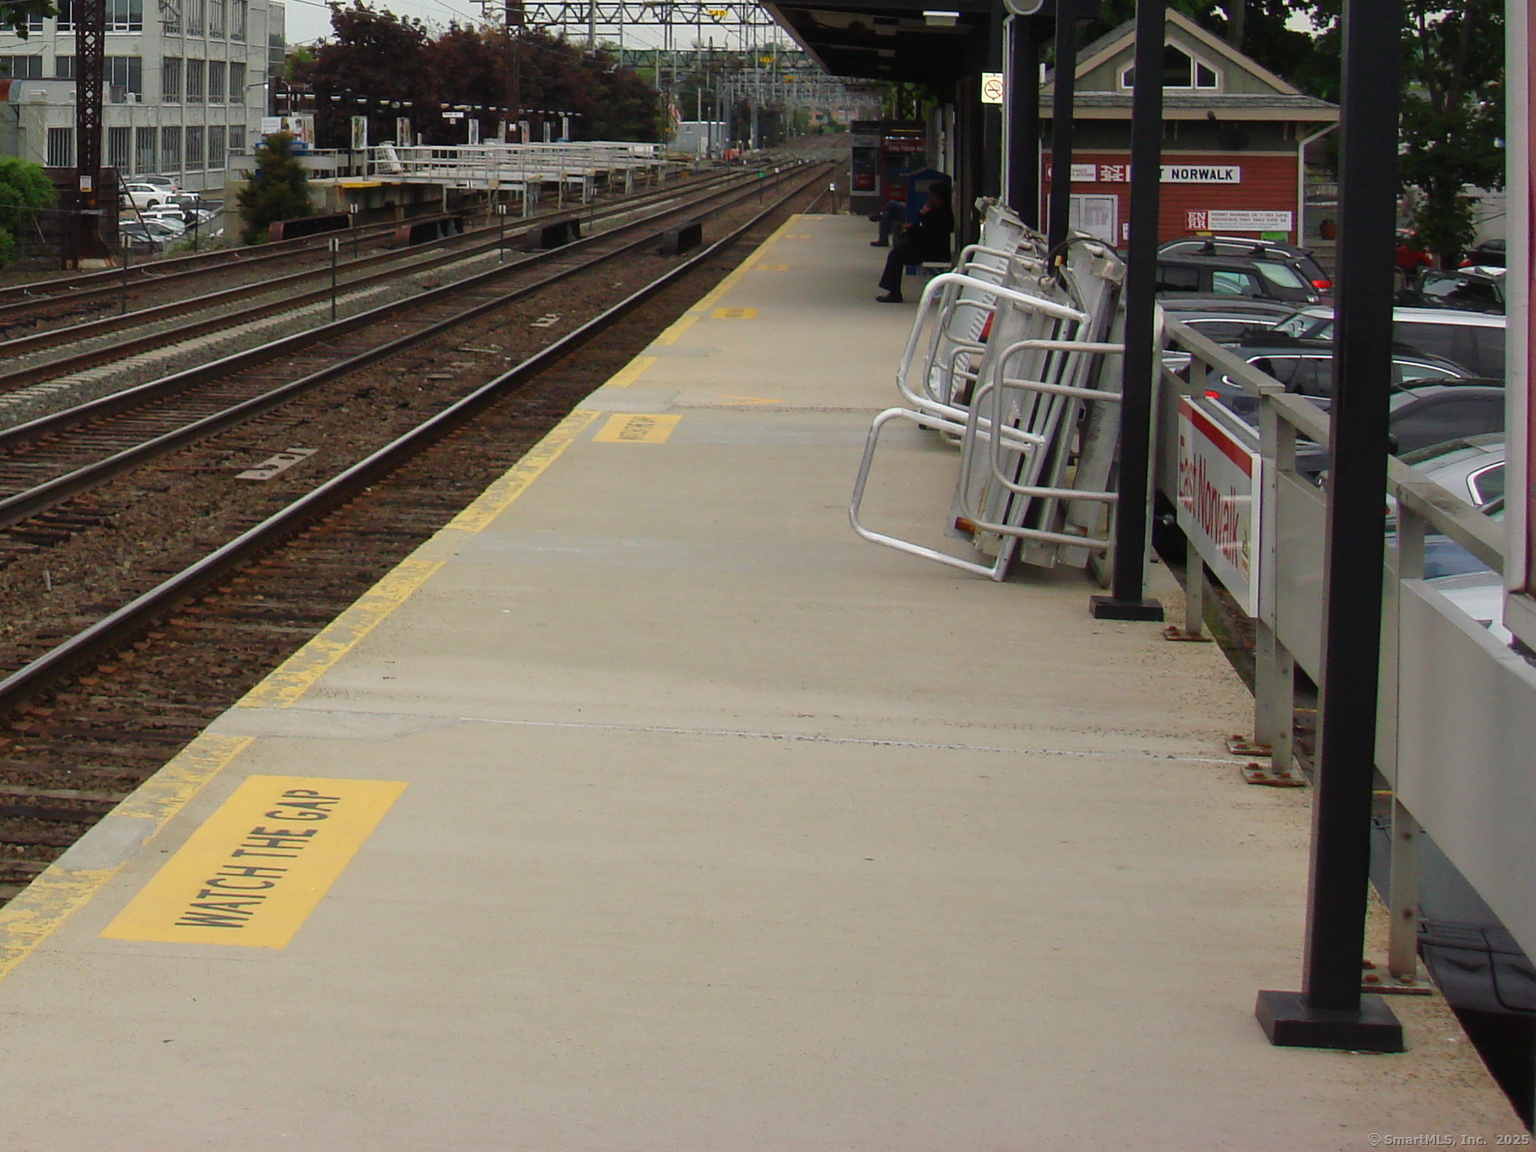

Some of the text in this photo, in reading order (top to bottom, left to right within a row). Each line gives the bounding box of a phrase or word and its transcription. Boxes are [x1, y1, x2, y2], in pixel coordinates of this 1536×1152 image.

[1171, 168, 1234, 180] NORWALK
[1178, 434, 1239, 570] East Norwalk
[174, 788, 342, 929] WATCH THE GAP
